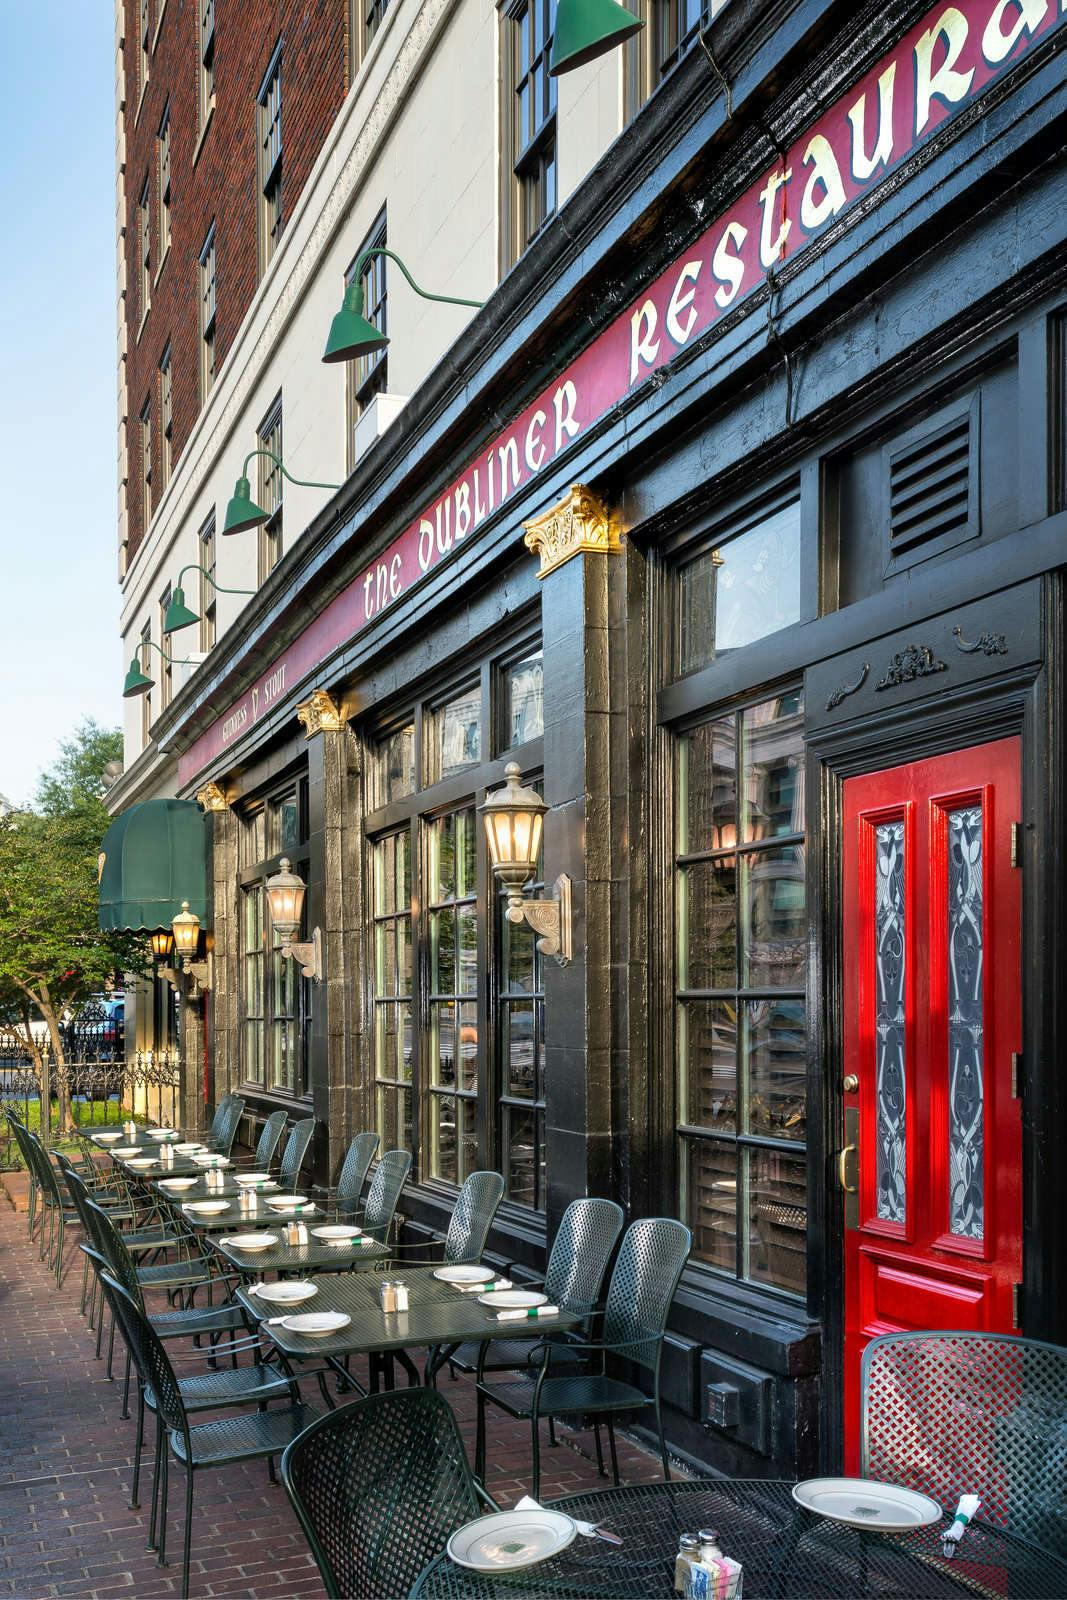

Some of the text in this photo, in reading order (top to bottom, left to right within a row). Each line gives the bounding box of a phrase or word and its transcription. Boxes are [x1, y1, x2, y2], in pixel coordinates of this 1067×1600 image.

[418, 379, 581, 571] DUBLINER
[630, 0, 1067, 386] REStaURa
[264, 663, 287, 705] STOUT
